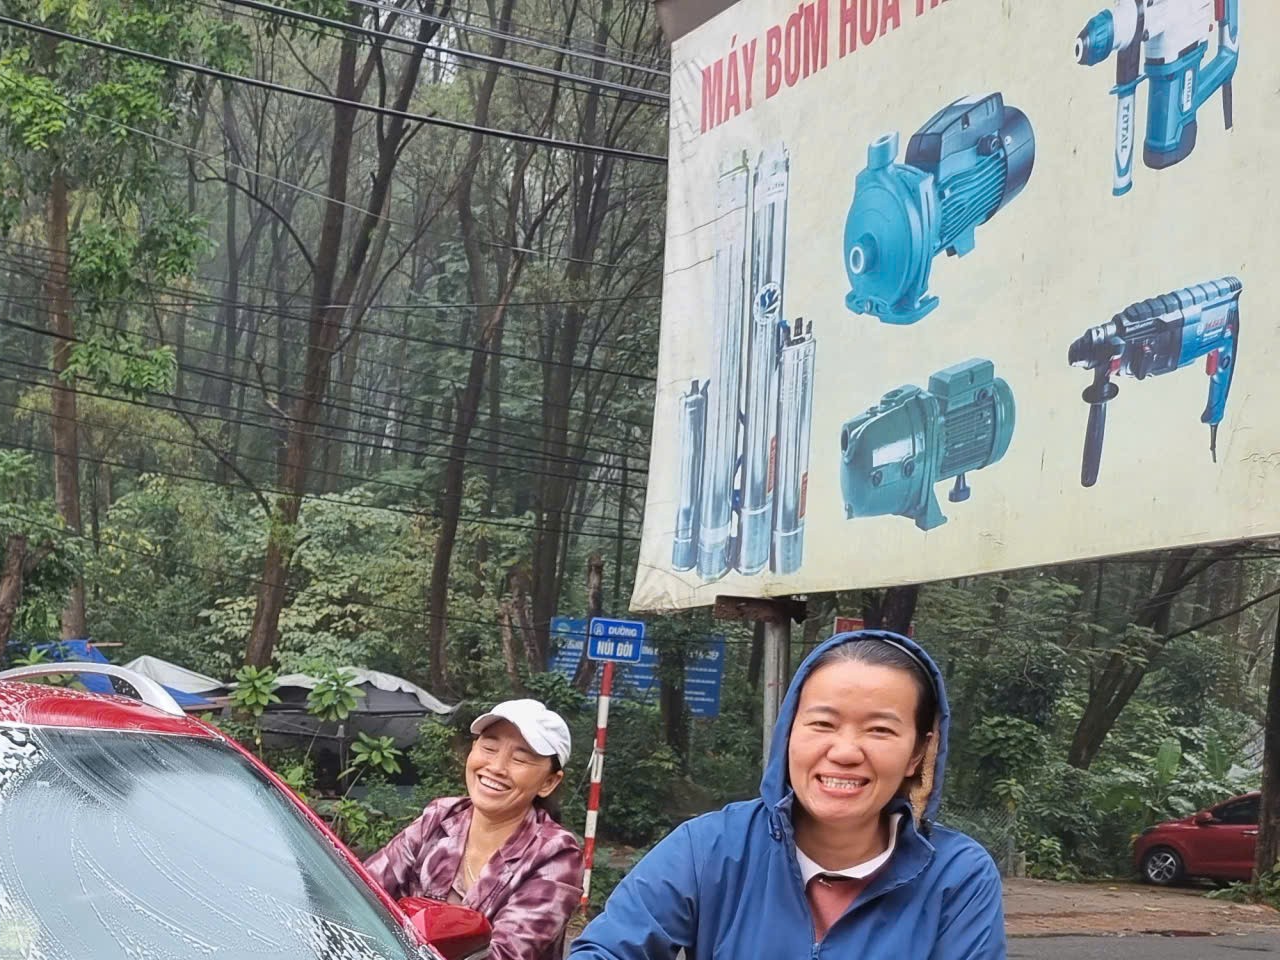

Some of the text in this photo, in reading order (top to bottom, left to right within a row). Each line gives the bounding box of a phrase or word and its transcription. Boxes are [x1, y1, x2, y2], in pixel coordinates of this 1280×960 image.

[701, 34, 757, 135] MÁY
[766, 0, 829, 99] BƠM
[597, 638, 614, 656] NÚI
